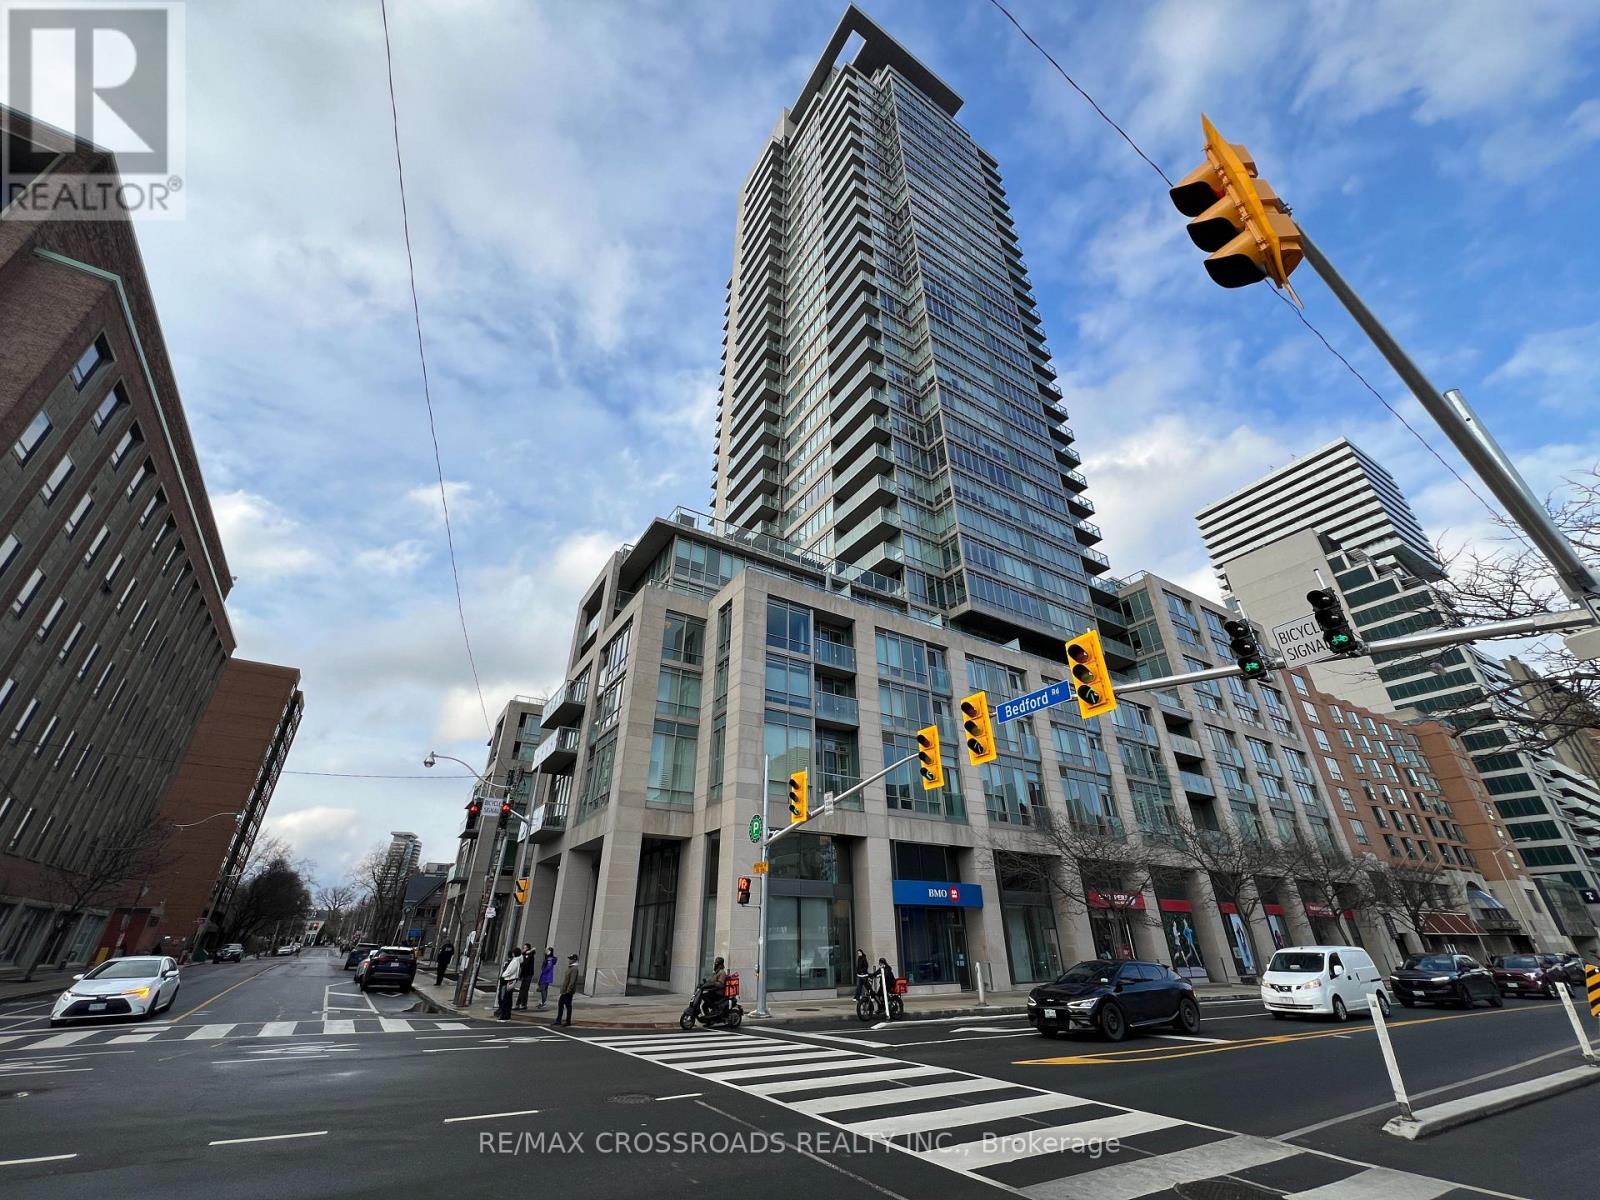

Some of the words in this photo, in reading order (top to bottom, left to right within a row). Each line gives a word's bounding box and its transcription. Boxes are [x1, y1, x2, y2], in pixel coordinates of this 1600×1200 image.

[1278, 621, 1322, 645] BICYCL
[1005, 691, 1049, 718] Bedford
[1051, 687, 1060, 696] Rd
[753, 821, 759, 834] P
[928, 888, 948, 898] BMO
